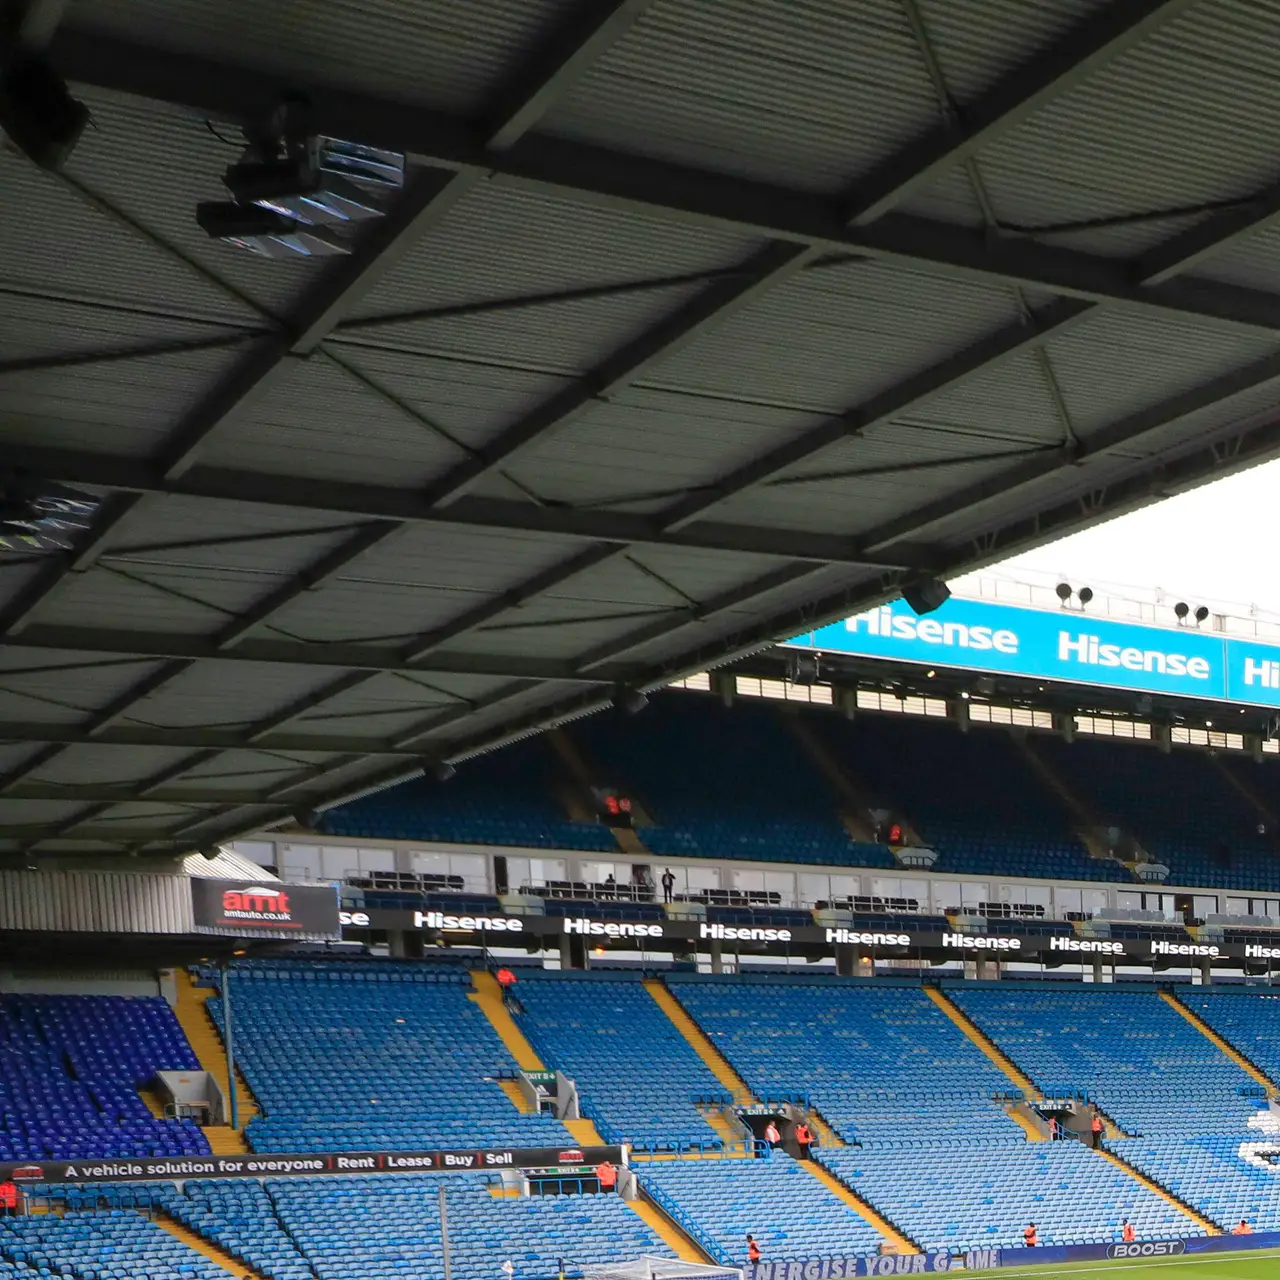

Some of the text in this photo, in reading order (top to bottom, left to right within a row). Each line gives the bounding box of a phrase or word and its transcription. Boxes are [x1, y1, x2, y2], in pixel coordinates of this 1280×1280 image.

[846, 608, 1019, 655] Hisense
[1058, 631, 1210, 679] Hisense
[222, 891, 290, 912] amt
[224, 910, 292, 921] amtauto.co.uk
[414, 911, 524, 933] Hisense
[564, 918, 664, 938] Hisense
[701, 923, 792, 942] Hisense
[826, 928, 911, 946] Hisense
[942, 932, 1021, 950] Hisense
[1050, 936, 1124, 954] Hisense
[1150, 940, 1220, 957] Hisense
[337, 1156, 375, 1170] Rent
[387, 1155, 433, 1168] Lease
[444, 1153, 474, 1167] Buy
[486, 1151, 513, 1164] Sell
[65, 1159, 324, 1178] A vehicle solution for everyone
[1113, 1241, 1179, 1257] BOOST
[864, 1254, 927, 1277] YOUR
